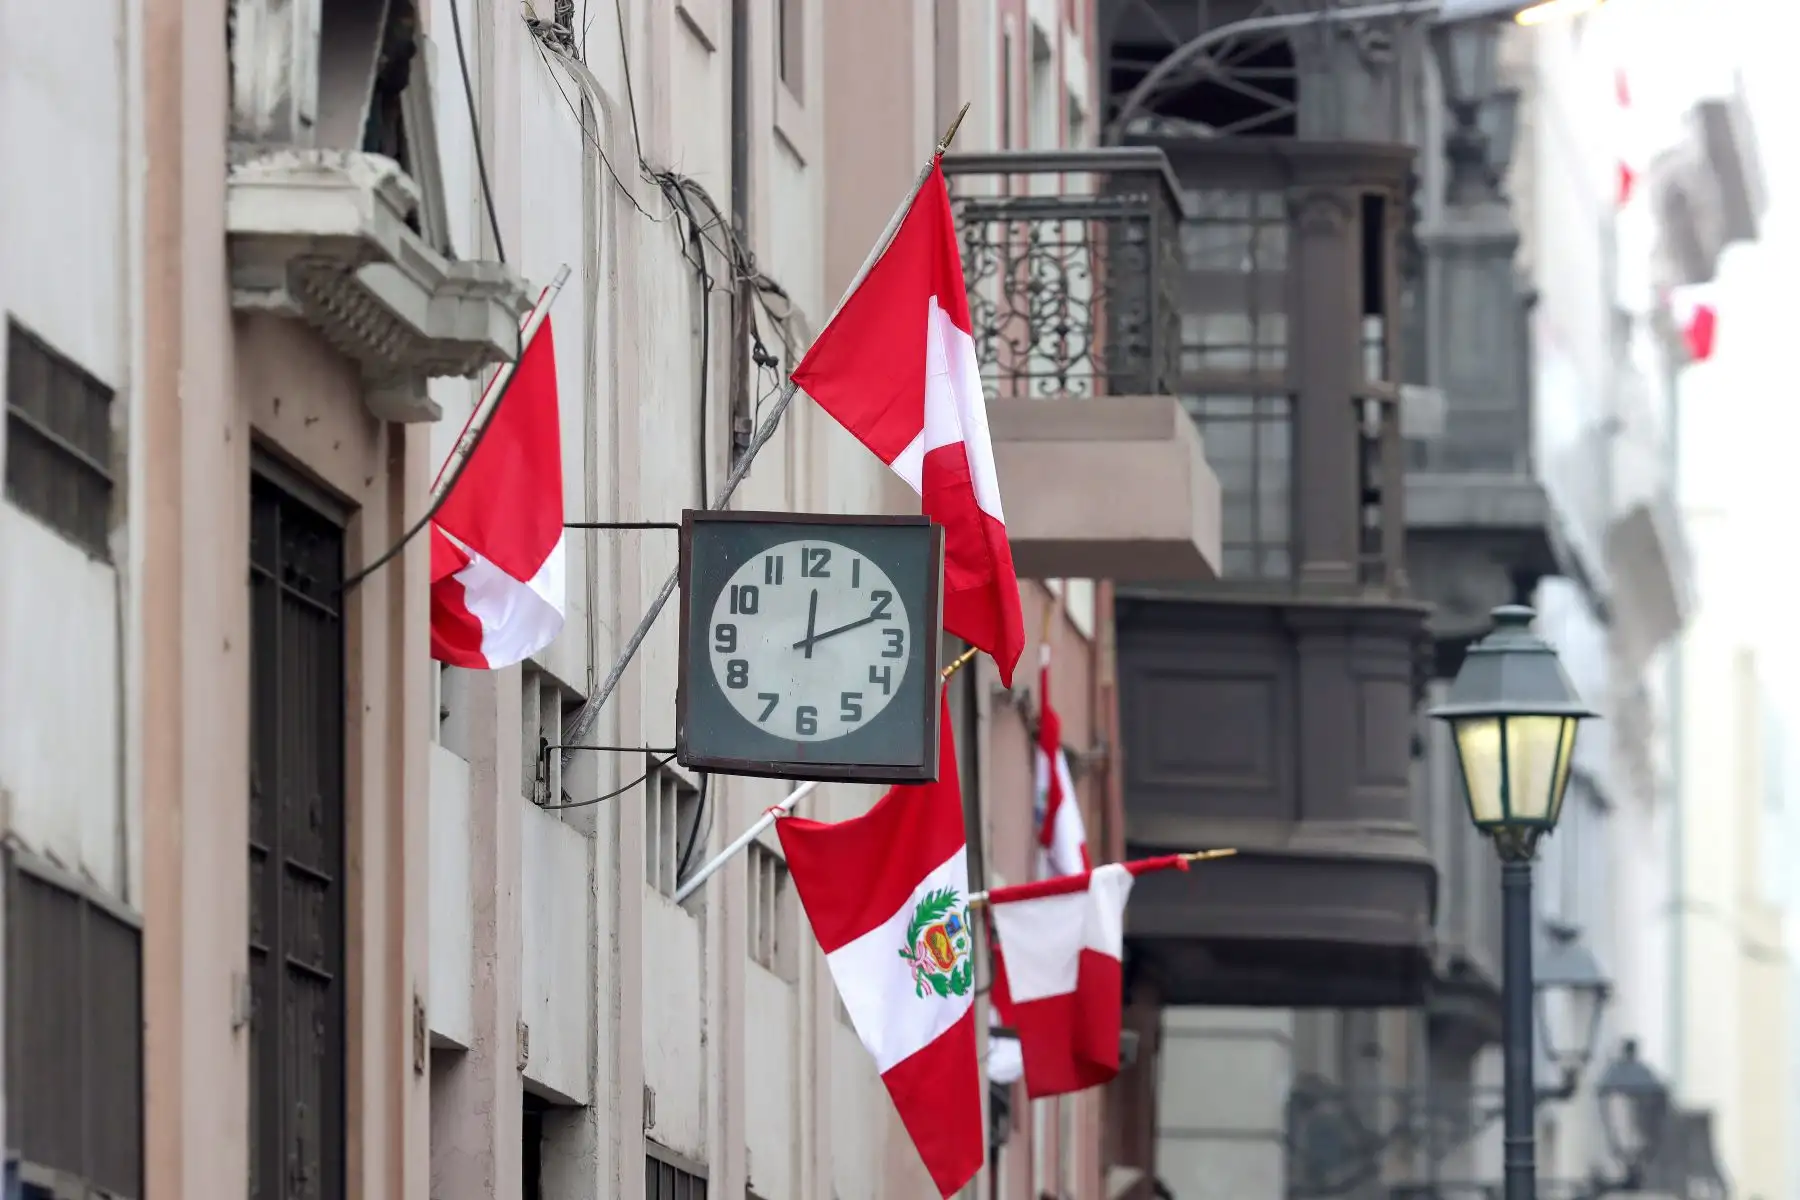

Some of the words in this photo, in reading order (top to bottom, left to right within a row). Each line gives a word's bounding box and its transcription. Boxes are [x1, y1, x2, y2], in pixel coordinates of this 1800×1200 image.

[764, 555, 784, 586] 11
[801, 547, 832, 578] 12
[851, 558, 861, 589] 1
[729, 584, 760, 615] 10
[870, 590, 892, 620] 2
[714, 623, 738, 654] 9
[881, 628, 904, 659] 3
[726, 659, 749, 690] 8
[868, 665, 891, 695] 4
[757, 692, 780, 723] 7
[795, 705, 818, 736] 6
[840, 691, 863, 722] 5
